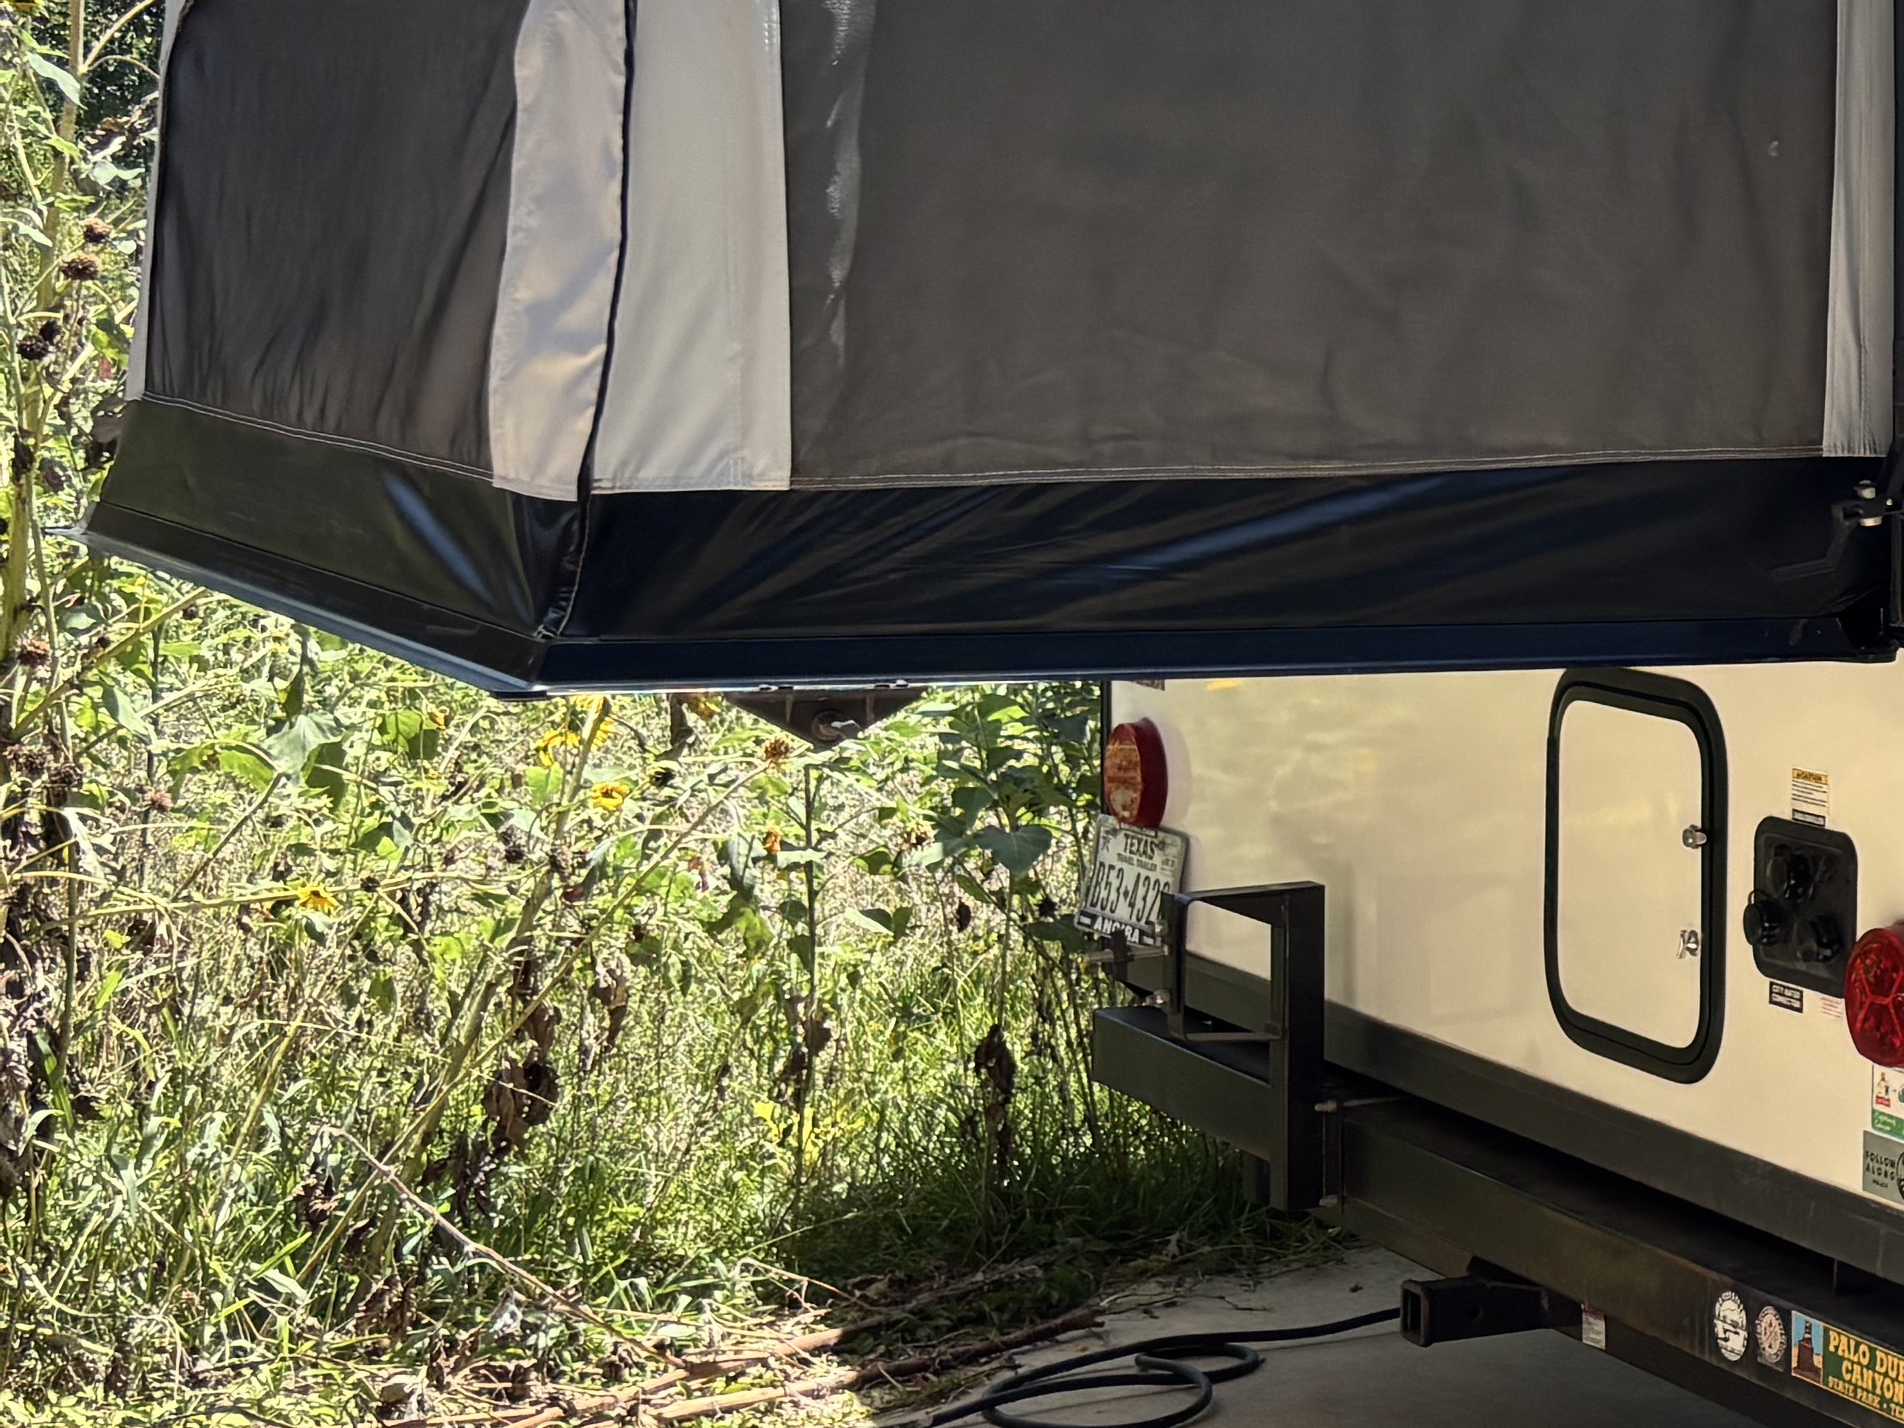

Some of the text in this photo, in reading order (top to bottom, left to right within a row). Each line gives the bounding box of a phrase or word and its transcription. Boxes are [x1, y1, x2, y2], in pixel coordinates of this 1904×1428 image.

[1123, 832, 1157, 861] TEXAS
[1829, 1330, 1870, 1366] PALO
[1841, 1360, 1904, 1405] CANYON
